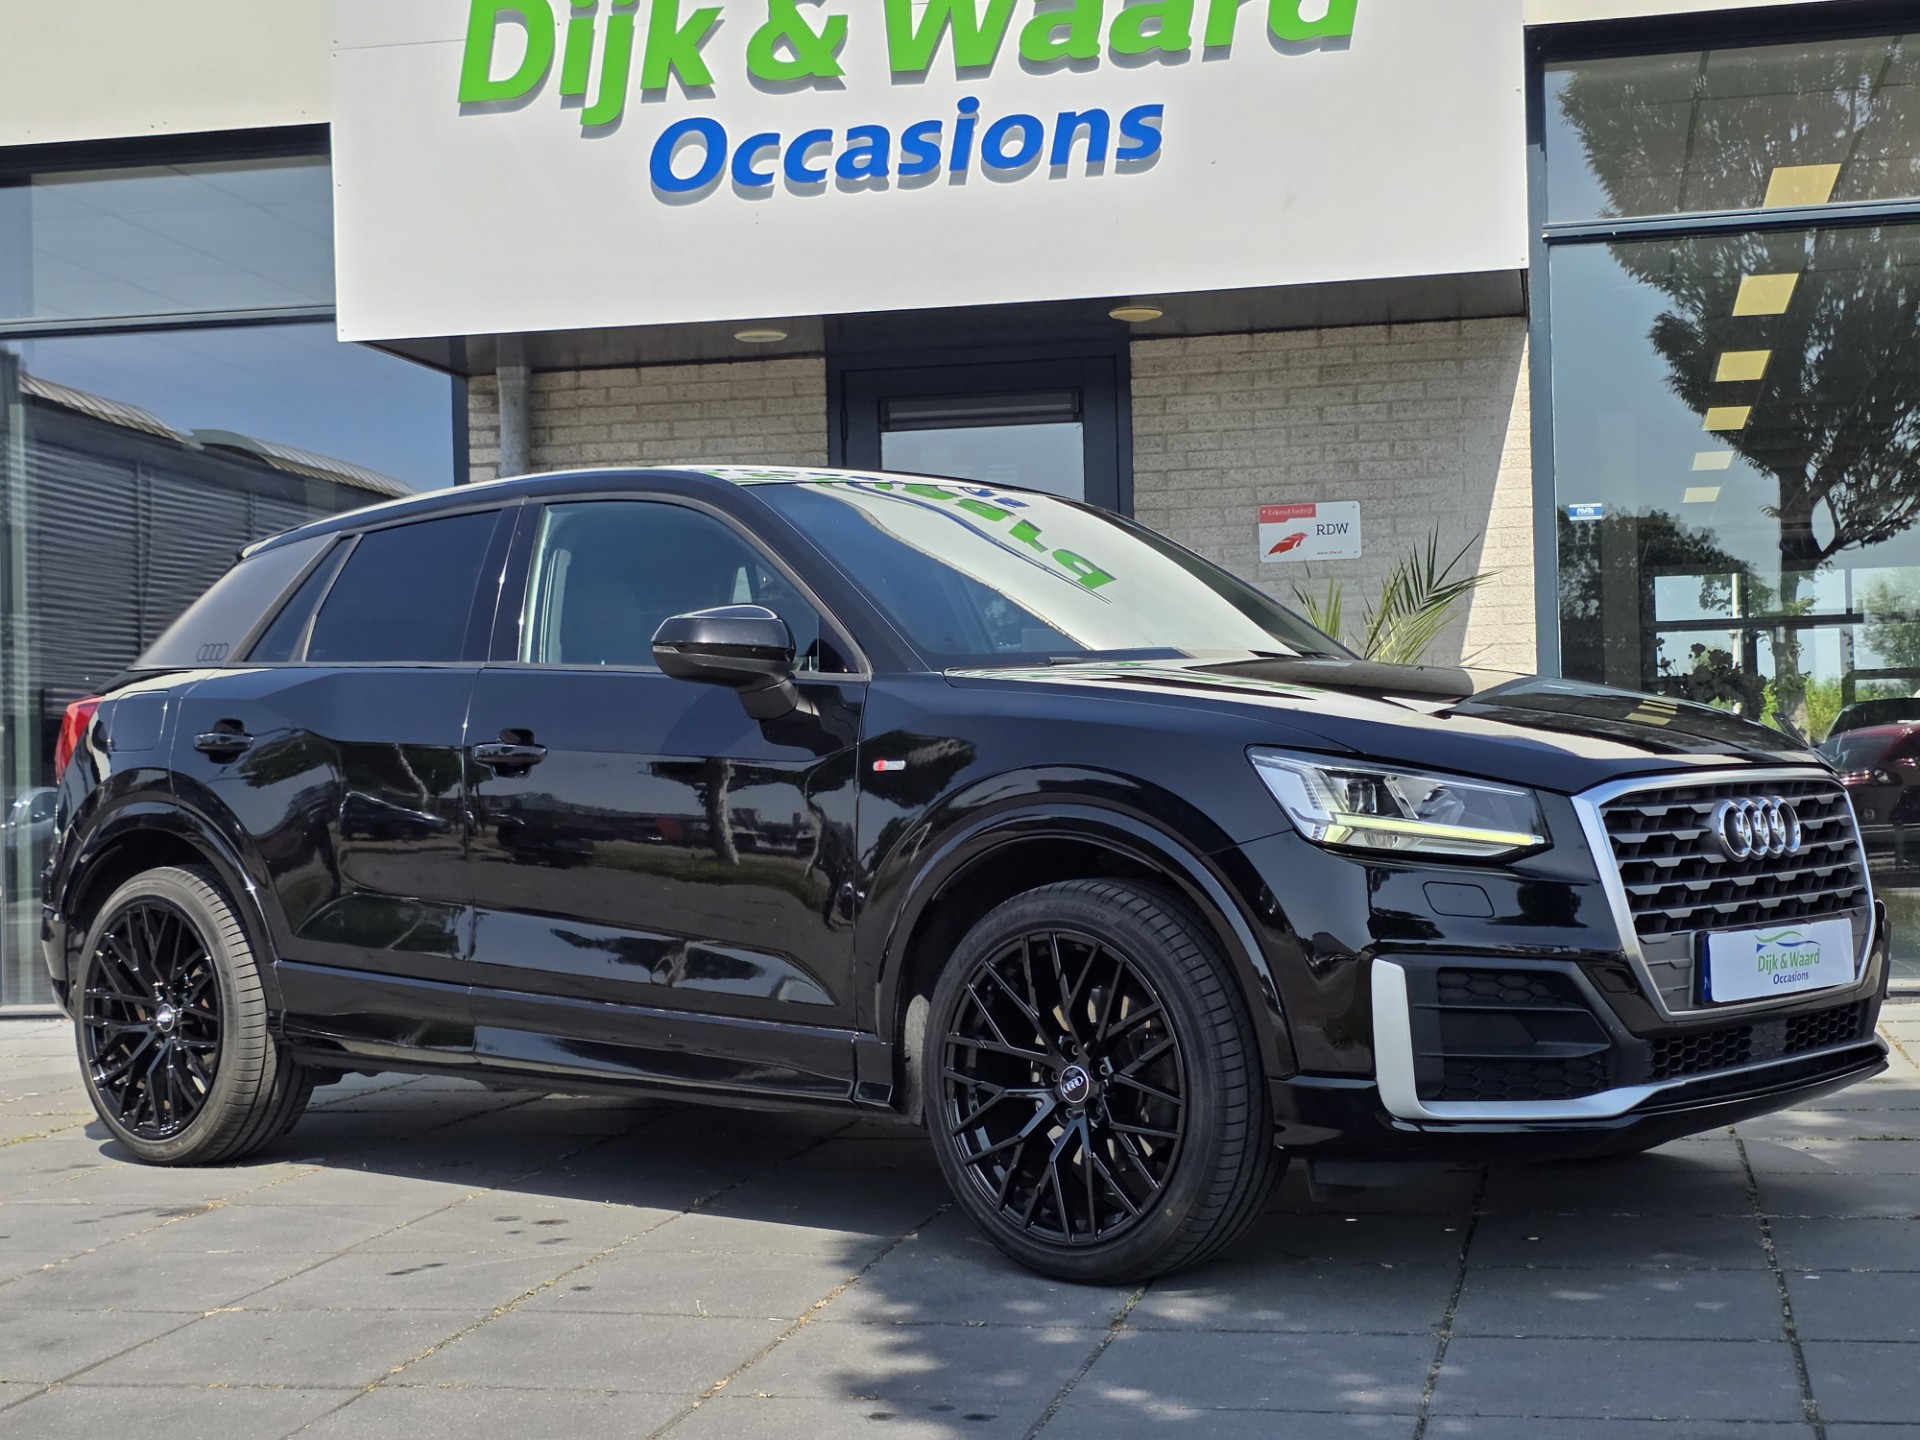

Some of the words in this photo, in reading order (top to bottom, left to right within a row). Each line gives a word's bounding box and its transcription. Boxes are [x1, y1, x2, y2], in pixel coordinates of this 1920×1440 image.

[460, 0, 719, 125] Dijk
[748, 0, 846, 80] &
[649, 96, 1164, 192] Occasions
[1316, 522, 1349, 536] RDW
[1757, 953, 1778, 976] Dijk
[1780, 953, 1788, 970] &
[1789, 947, 1820, 968] Waard
[1773, 970, 1809, 985] Occasions
